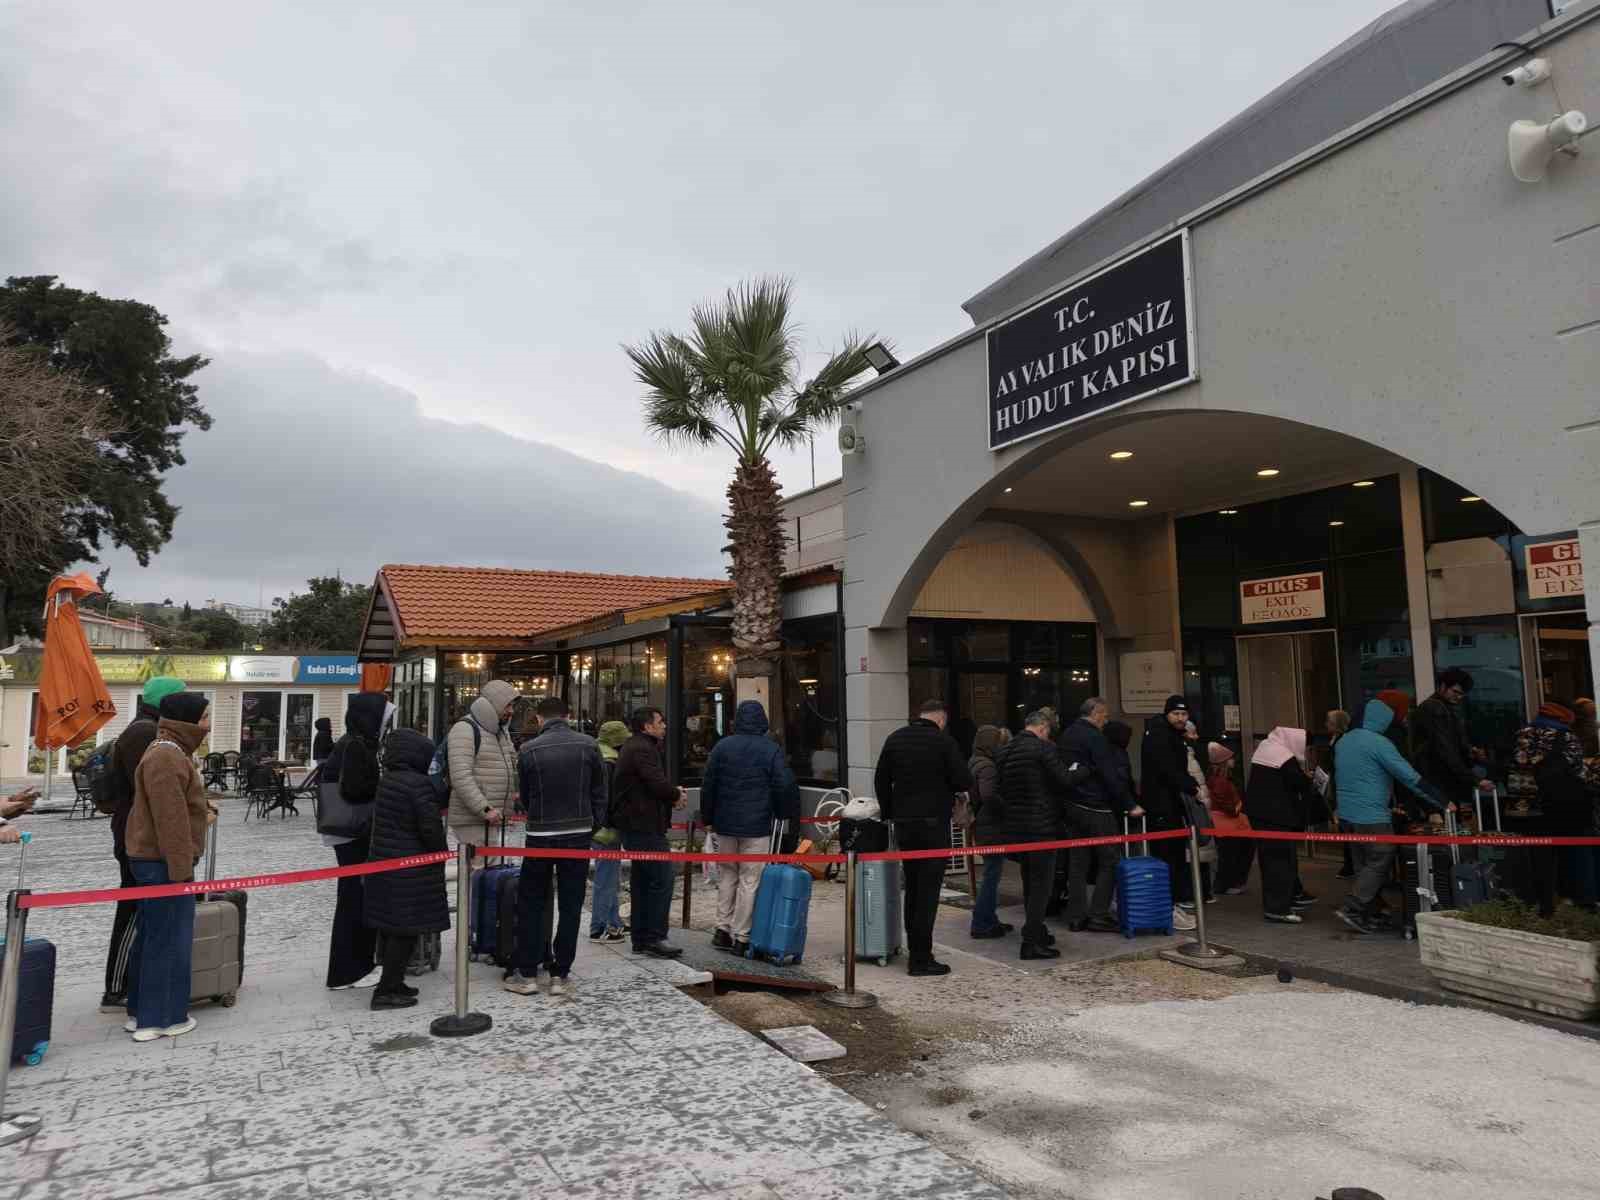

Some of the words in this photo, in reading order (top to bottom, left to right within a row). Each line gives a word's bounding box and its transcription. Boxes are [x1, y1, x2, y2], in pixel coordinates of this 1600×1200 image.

[1054, 297, 1095, 333] T.C.
[1093, 300, 1174, 356] DENİZ
[997, 381, 1075, 432] HUDUT
[1082, 338, 1178, 399] KAPISI
[1265, 595, 1296, 608] EXIT
